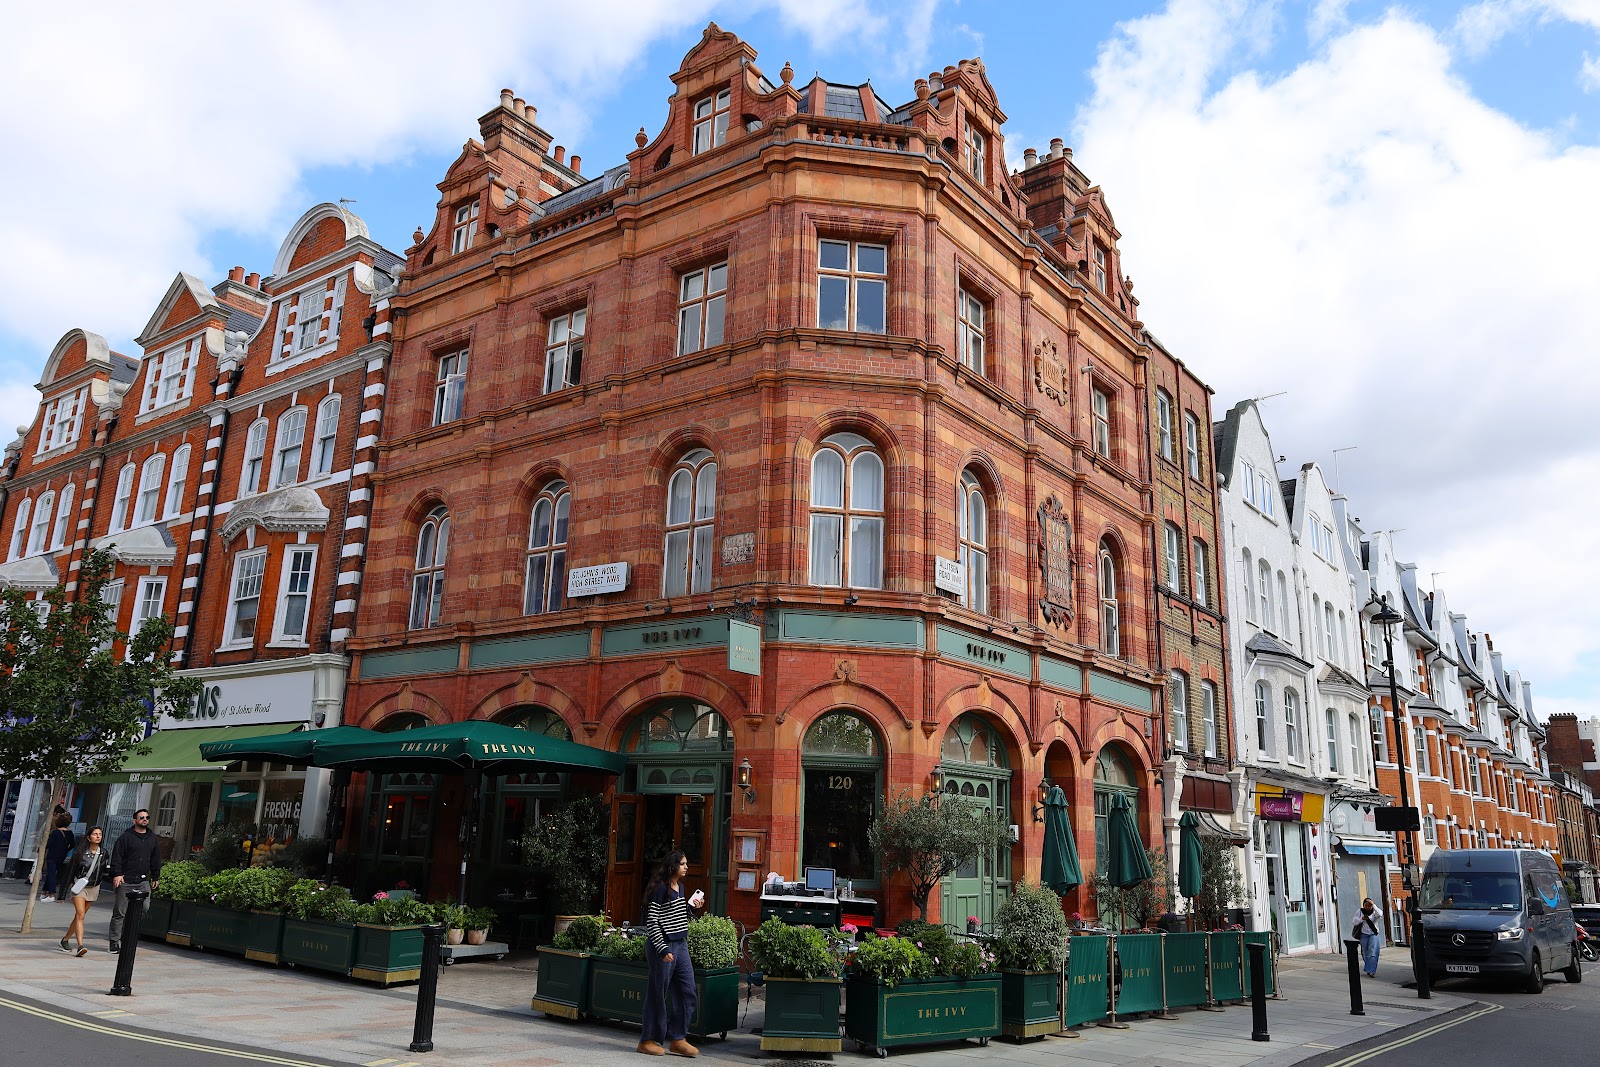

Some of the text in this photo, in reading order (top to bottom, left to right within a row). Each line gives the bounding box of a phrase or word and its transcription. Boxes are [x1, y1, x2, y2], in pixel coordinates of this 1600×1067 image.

[601, 566, 618, 576] WOOD
[584, 576, 604, 586] STREET
[641, 627, 701, 643] THE IVY
[966, 642, 1007, 665] THE IVY
[176, 685, 272, 721] ENS of St Johns Wood
[400, 742, 449, 752] THE IVY
[482, 744, 535, 755] THE IVY
[828, 776, 852, 789] 120
[264, 801, 301, 819] FRESH &
[316, 942, 328, 951] IVY
[1173, 964, 1196, 974] THE IVY
[1213, 961, 1234, 970] THE IVY
[1137, 967, 1151, 977] IVY
[1073, 973, 1102, 985] THE IVY
[622, 989, 641, 1000] THE
[917, 1006, 967, 1019] THE IVY
